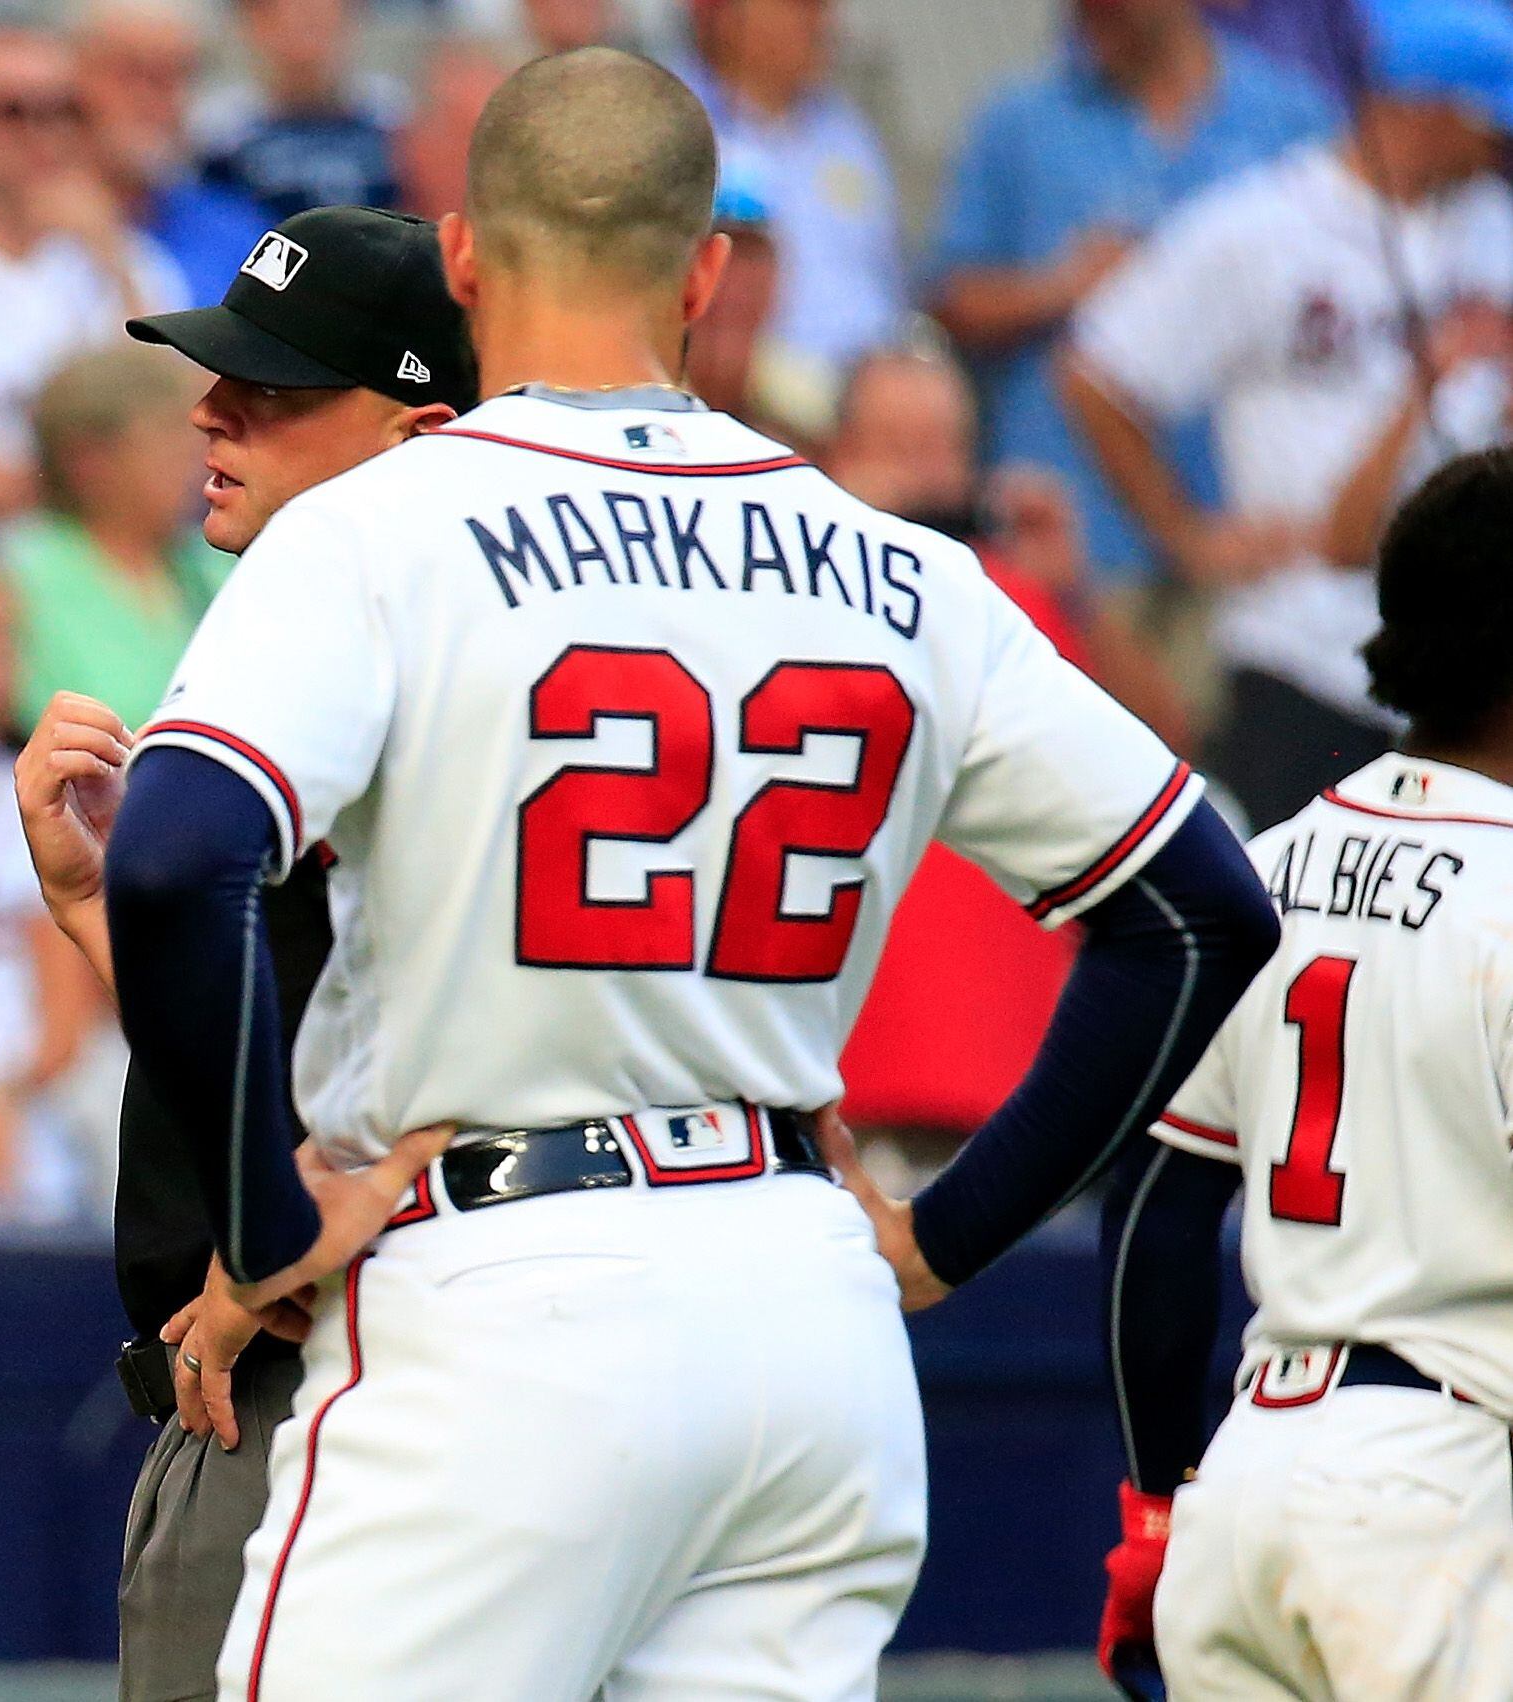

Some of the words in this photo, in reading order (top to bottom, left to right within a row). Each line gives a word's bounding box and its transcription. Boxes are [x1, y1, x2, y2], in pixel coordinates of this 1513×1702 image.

[464, 490, 922, 640] MARKAKIS
[515, 643, 915, 984] 22
[1267, 830, 1465, 931] ALBIES
[1270, 954, 1359, 1227] 1
